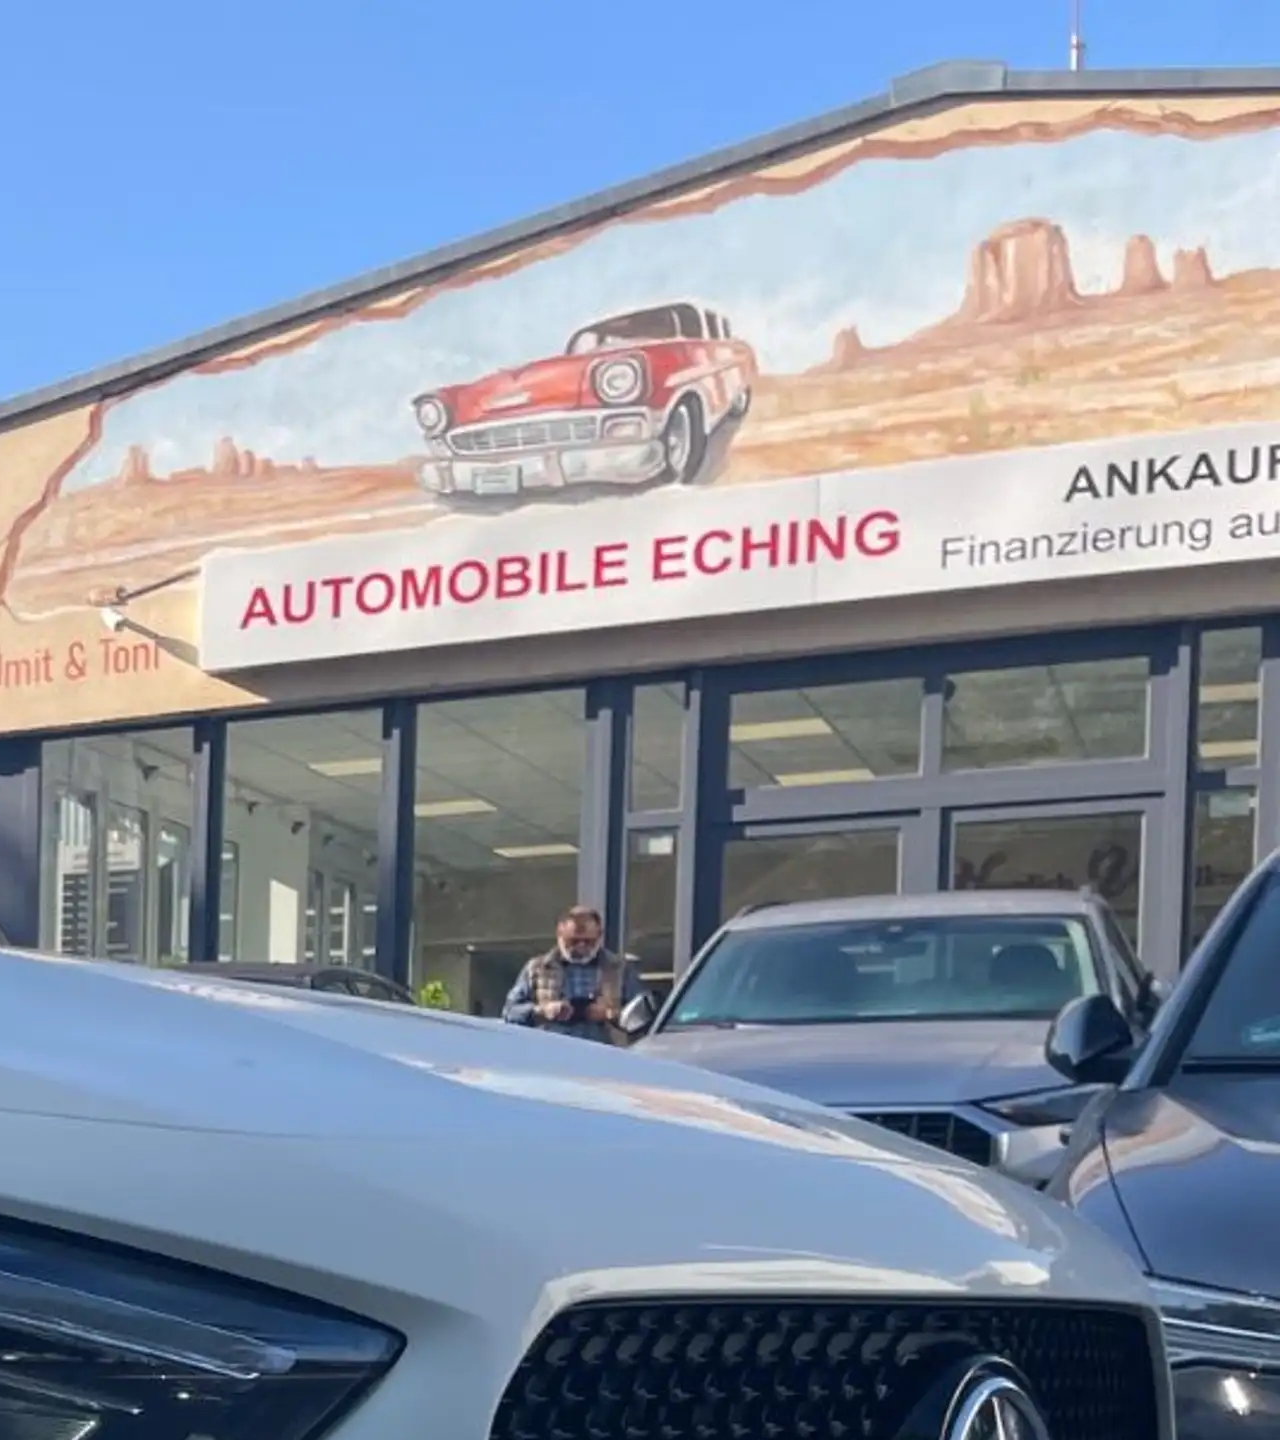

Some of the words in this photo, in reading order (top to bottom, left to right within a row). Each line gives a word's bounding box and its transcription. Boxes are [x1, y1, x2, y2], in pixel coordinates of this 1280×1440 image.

[239, 542, 629, 630] AUTOMOBILE
[651, 509, 901, 580] ECHING
[941, 517, 1213, 570] Finanzierung
[65, 641, 86, 680] &
[100, 637, 160, 675] Toni
